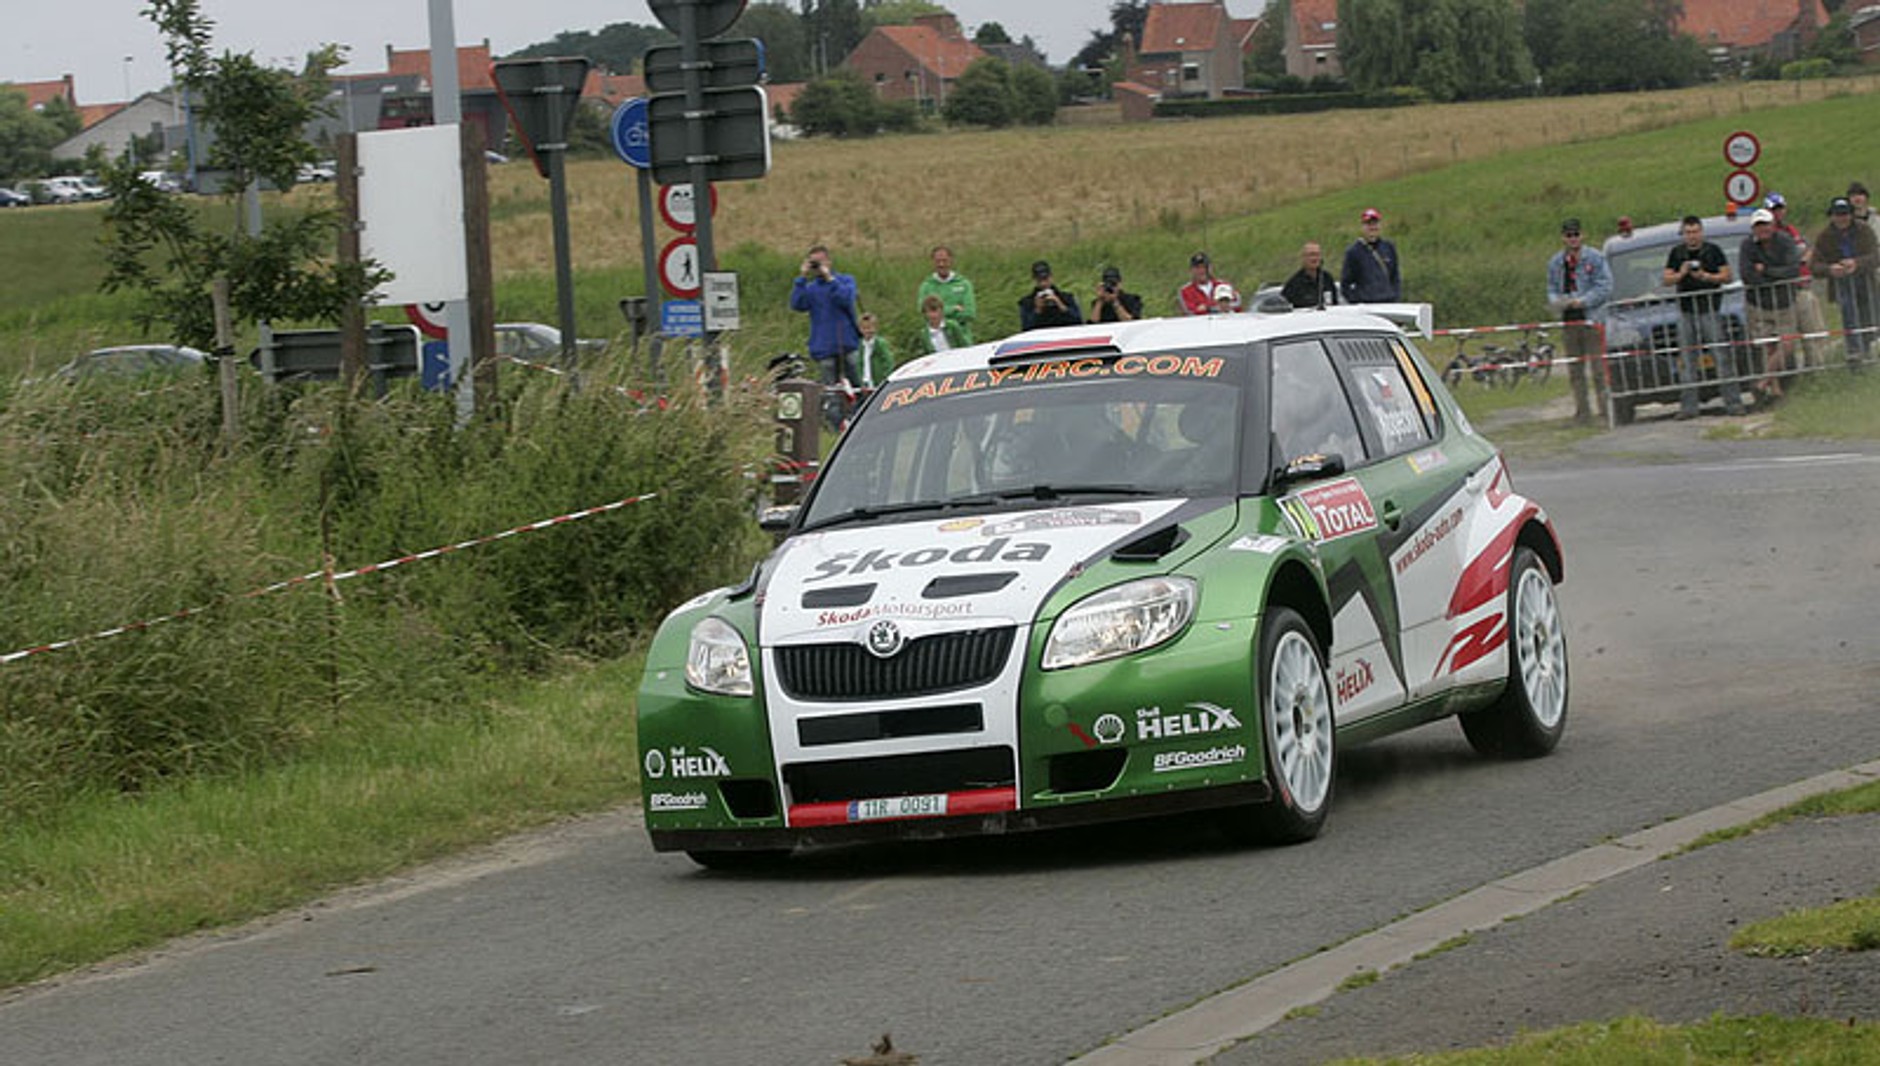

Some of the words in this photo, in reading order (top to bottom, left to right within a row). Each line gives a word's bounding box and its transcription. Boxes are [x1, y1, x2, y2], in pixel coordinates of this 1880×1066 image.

[880, 355, 1225, 411] RALLY-IRC.COM
[1137, 702, 1242, 740] HELIX
[671, 747, 732, 778] HELIX
[1154, 745, 1246, 770] BFGoodrich
